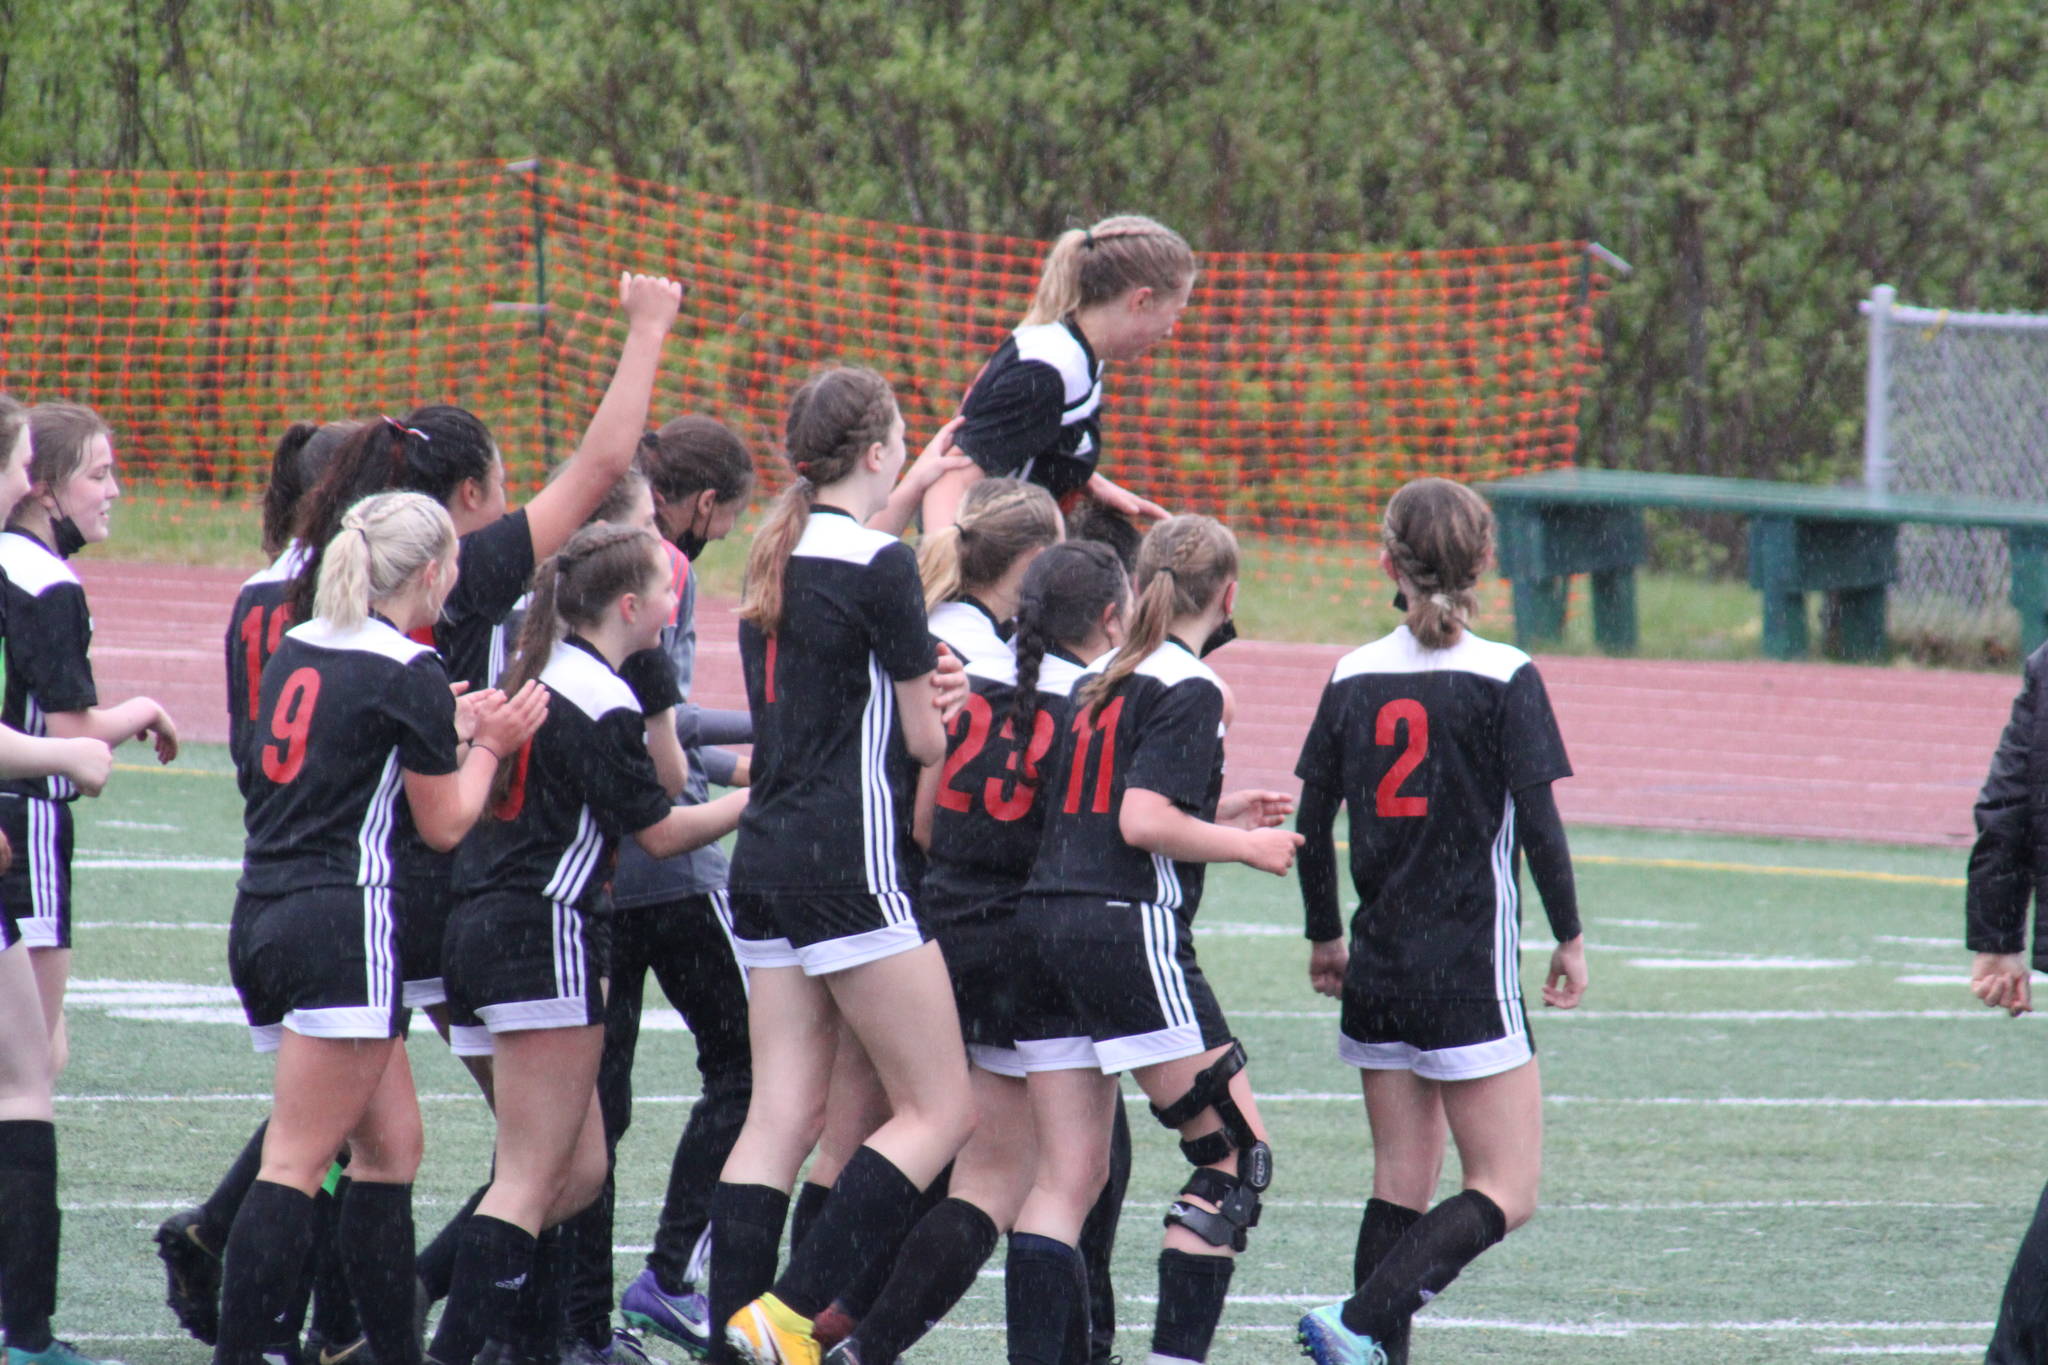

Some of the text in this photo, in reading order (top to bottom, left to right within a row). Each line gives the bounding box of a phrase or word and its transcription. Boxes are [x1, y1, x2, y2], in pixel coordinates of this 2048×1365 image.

[262, 667, 321, 784] 9
[935, 692, 1055, 822] 23
[1063, 696, 1125, 814] 11
[1375, 698, 1428, 817] 2
